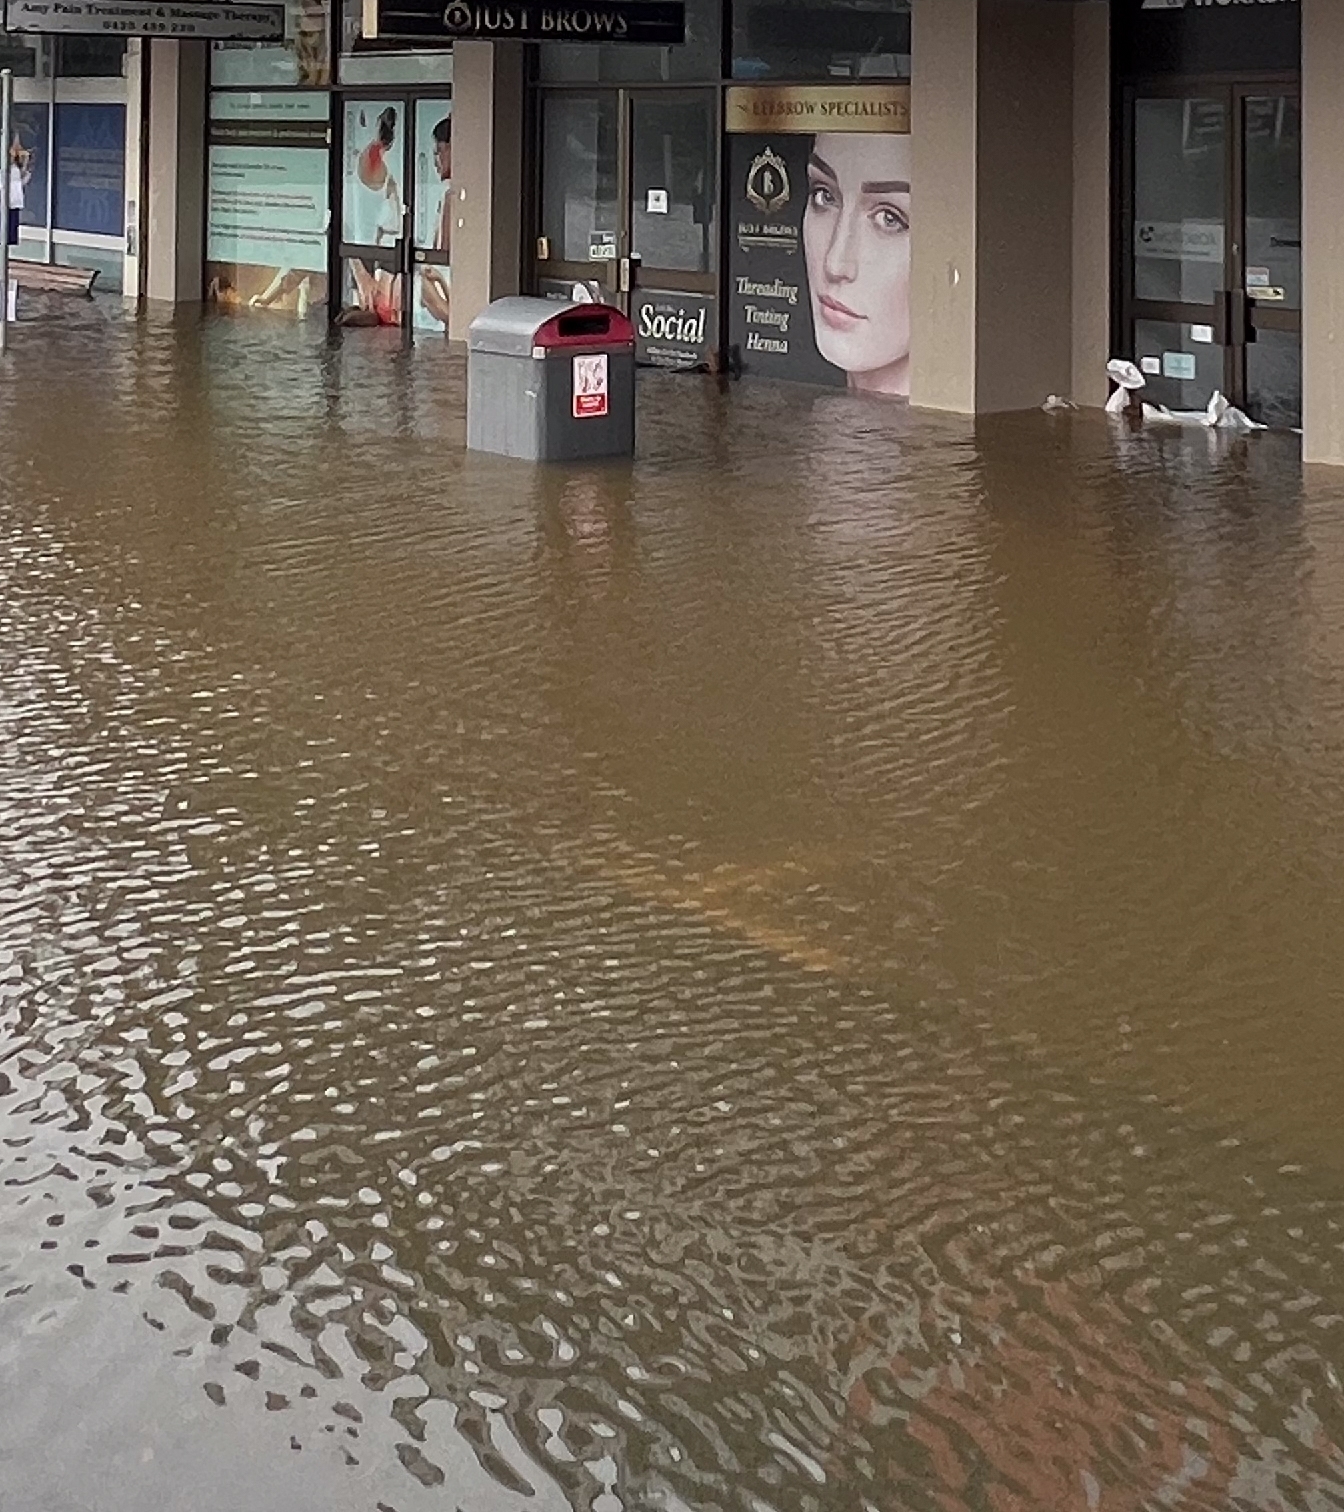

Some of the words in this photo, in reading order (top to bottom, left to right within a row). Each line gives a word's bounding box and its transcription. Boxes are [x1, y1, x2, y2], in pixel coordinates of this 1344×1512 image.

[21, 3, 49, 15] Amy
[53, 3, 82, 15] Pain
[86, 4, 151, 16] Treatment
[155, 7, 166, 17] &
[170, 7, 219, 21] Massage
[474, 6, 528, 37] JUST
[541, 10, 627, 33] BROWS
[821, 101, 910, 117] SPECIALISTS
[736, 277, 798, 304] Threading
[638, 303, 706, 343] Social
[744, 305, 790, 332] Tinting
[746, 333, 788, 354] Henna
